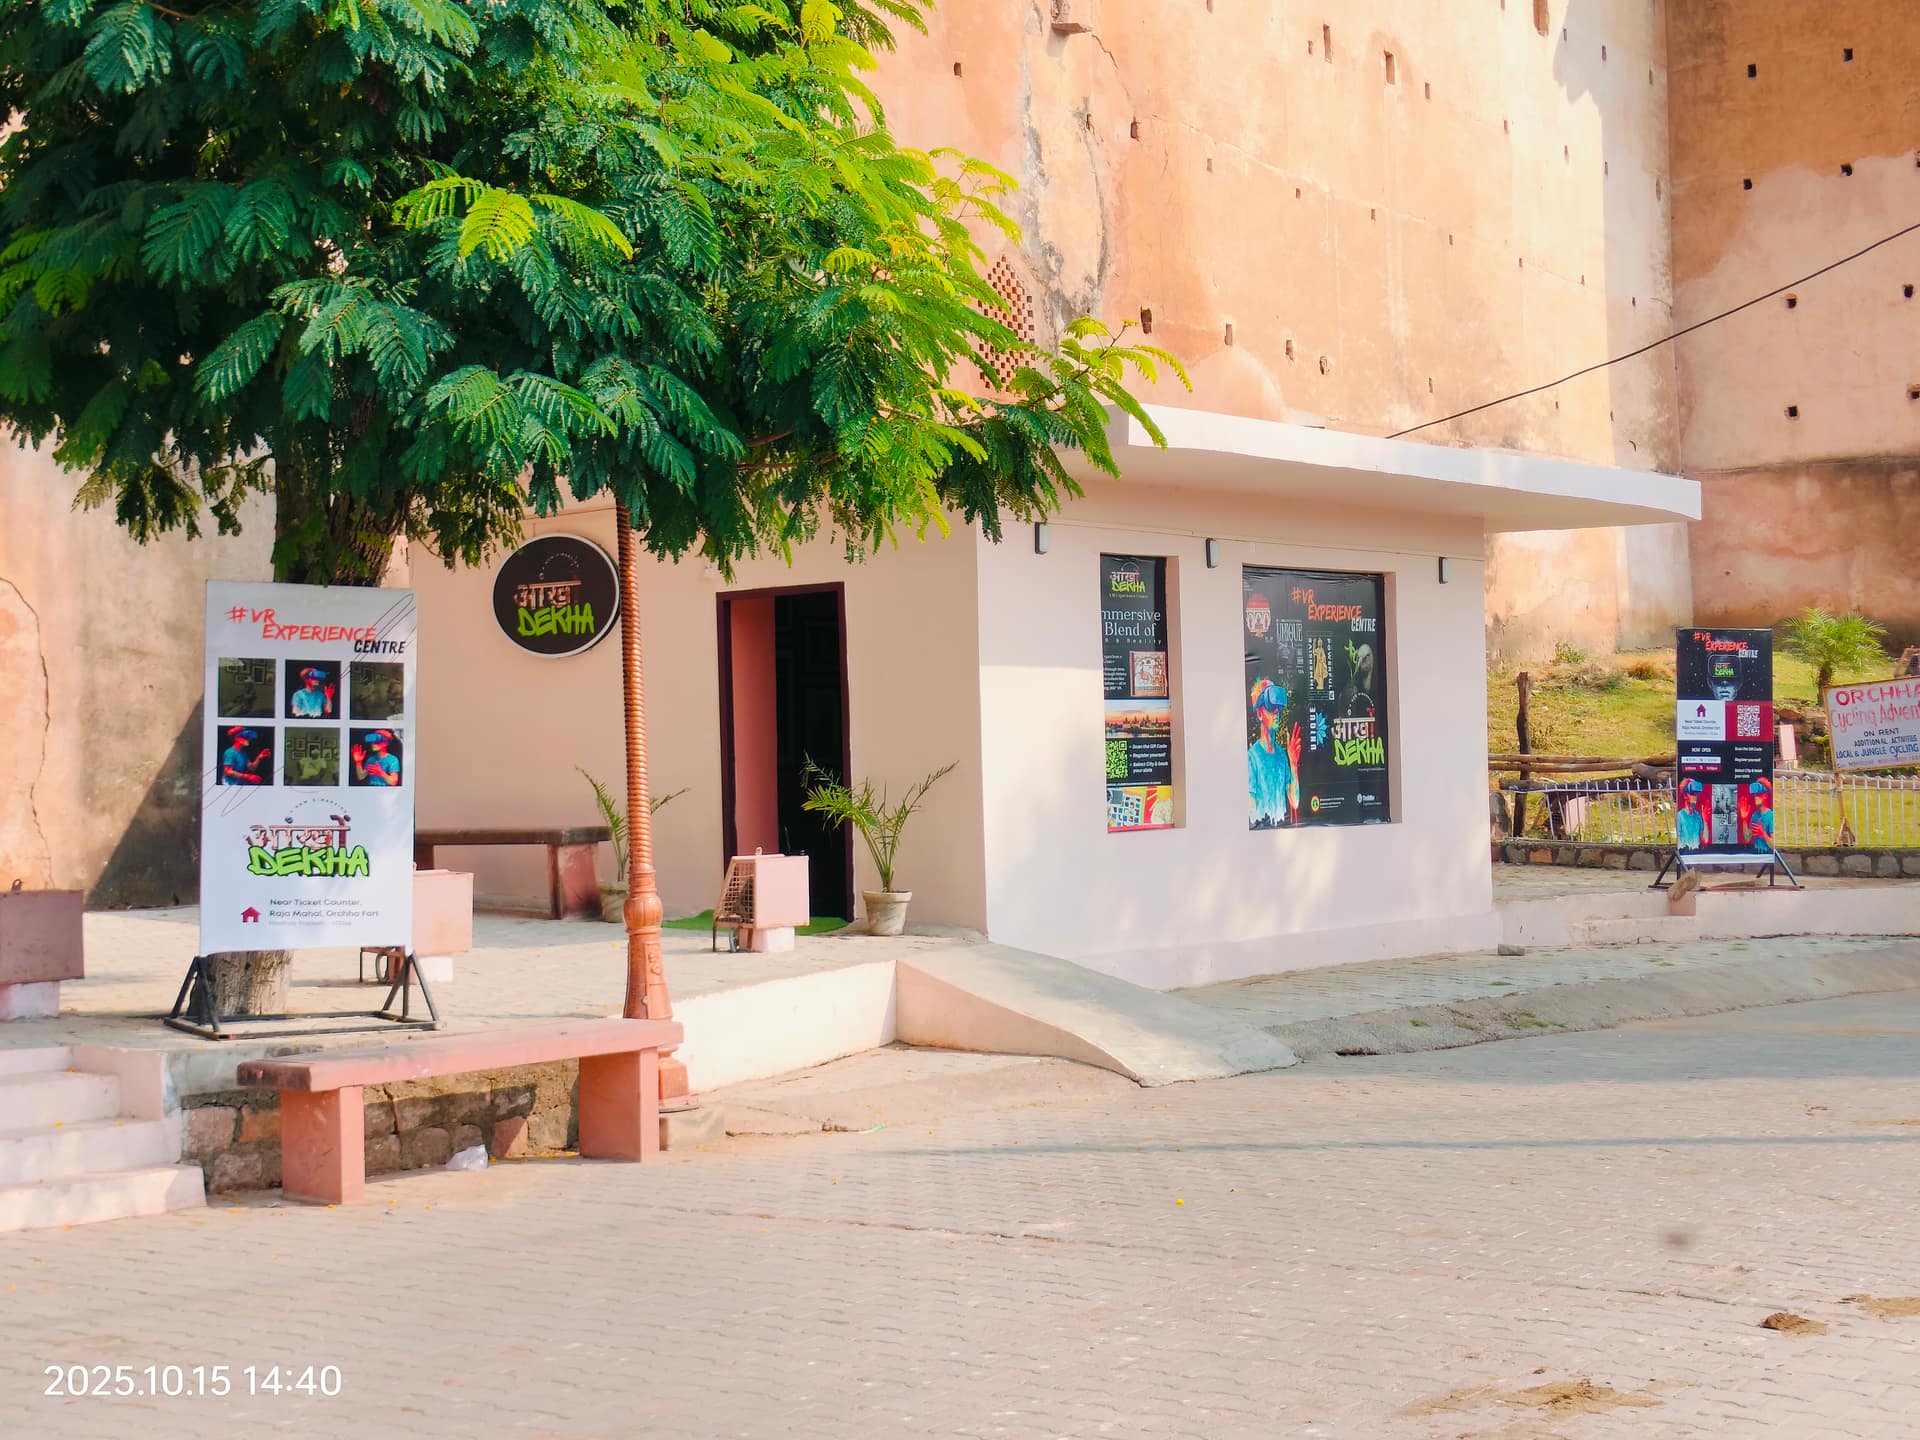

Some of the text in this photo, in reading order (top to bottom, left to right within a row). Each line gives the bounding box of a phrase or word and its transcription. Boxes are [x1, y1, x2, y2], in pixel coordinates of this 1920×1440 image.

[1111, 580, 1146, 592] DEKHA
[517, 602, 595, 637] DEKHA
[1100, 608, 1161, 621] mmersive
[1307, 604, 1363, 622] EXPERIENCE
[262, 623, 377, 642] EXPERIENCE
[1105, 621, 1158, 637] Blend of
[1351, 618, 1377, 632] CENTRE
[353, 640, 407, 654] CENTRE
[1705, 640, 1748, 652] EXPERIENCE
[1879, 701, 1920, 723] Adven
[1879, 728, 1899, 736] RENT
[1334, 736, 1385, 766] DEKHA
[1836, 750, 1853, 759] LOCAL
[1861, 746, 1888, 757] JUNGLE
[1889, 743, 1919, 758] CYCLING
[247, 845, 370, 877] DEKHA
